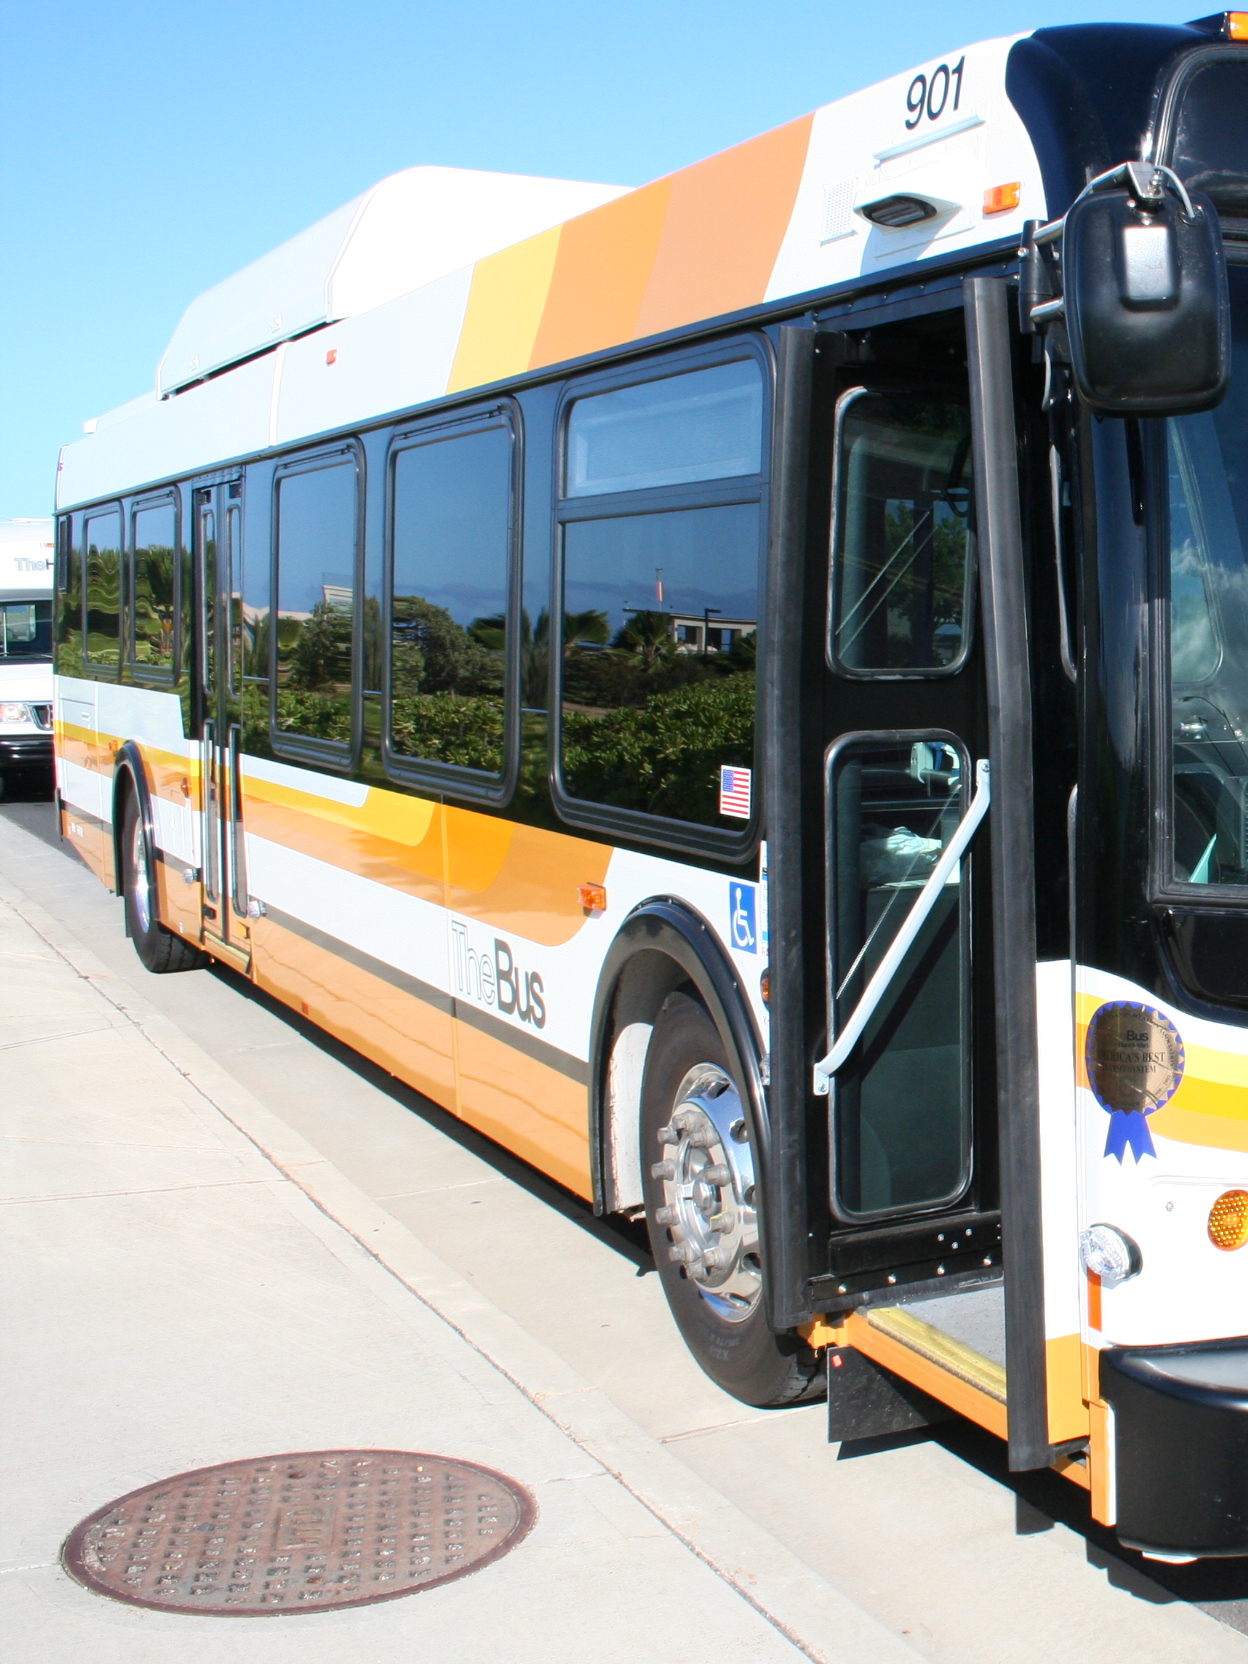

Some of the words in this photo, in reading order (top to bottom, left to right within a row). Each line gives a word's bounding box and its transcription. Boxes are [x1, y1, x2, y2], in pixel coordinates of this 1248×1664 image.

[905, 54, 966, 131] 901
[451, 919, 547, 1030] TheBus
[1142, 1051, 1166, 1063] BEST
